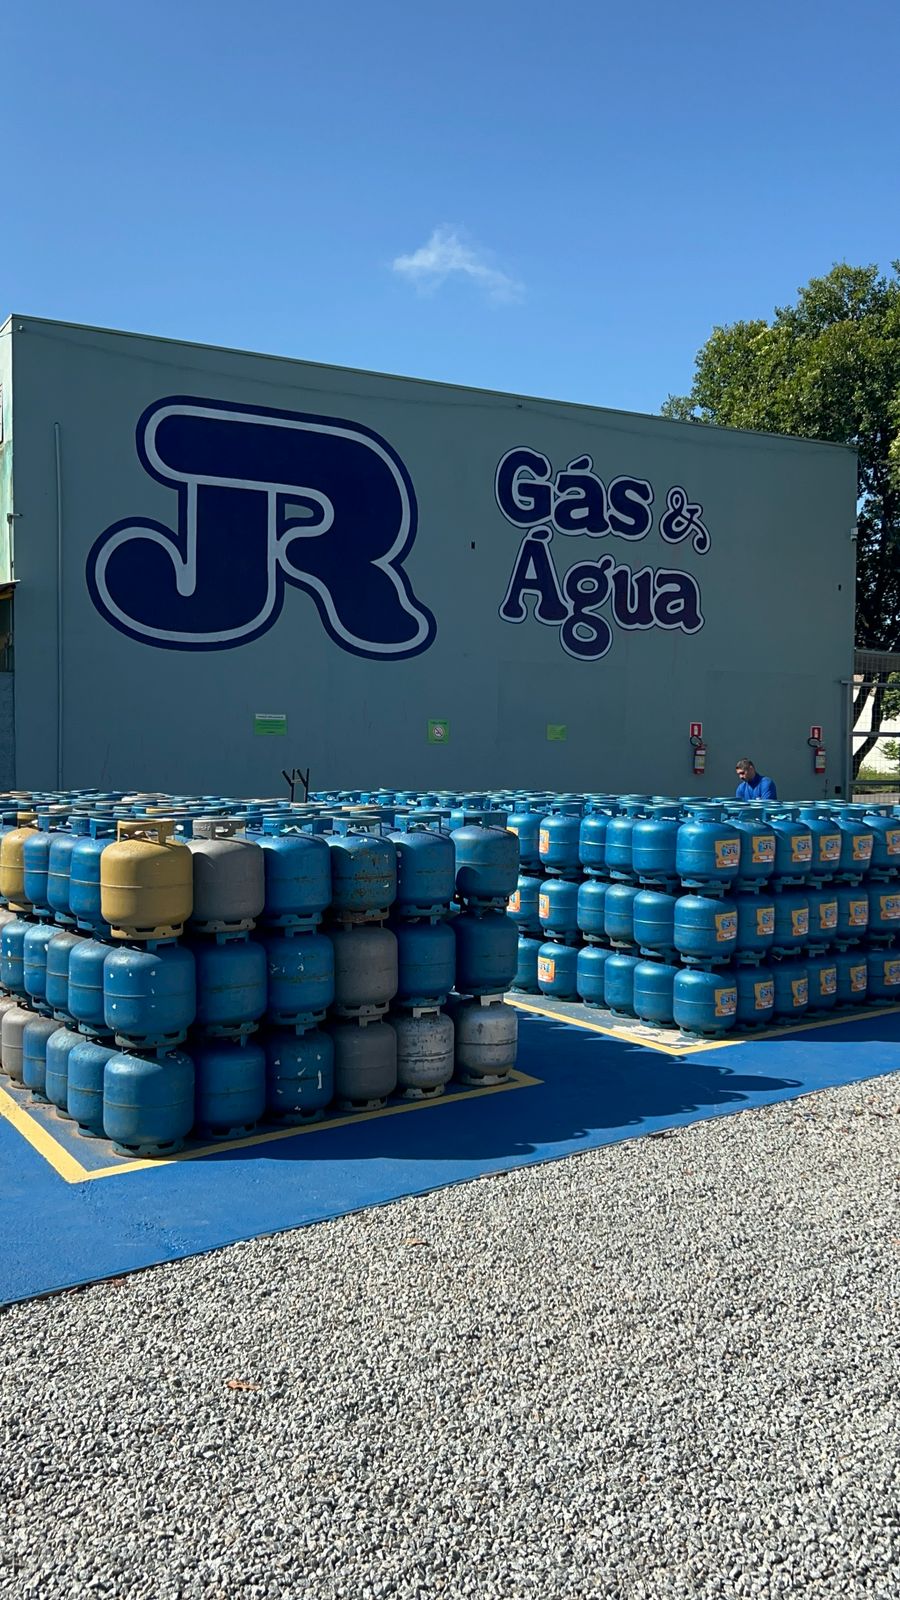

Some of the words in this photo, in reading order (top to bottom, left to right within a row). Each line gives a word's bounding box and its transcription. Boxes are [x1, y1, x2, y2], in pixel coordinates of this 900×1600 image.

[87, 396, 436, 660] JR
[495, 447, 654, 541] Gás
[659, 486, 711, 554] &
[499, 525, 704, 661] Água
